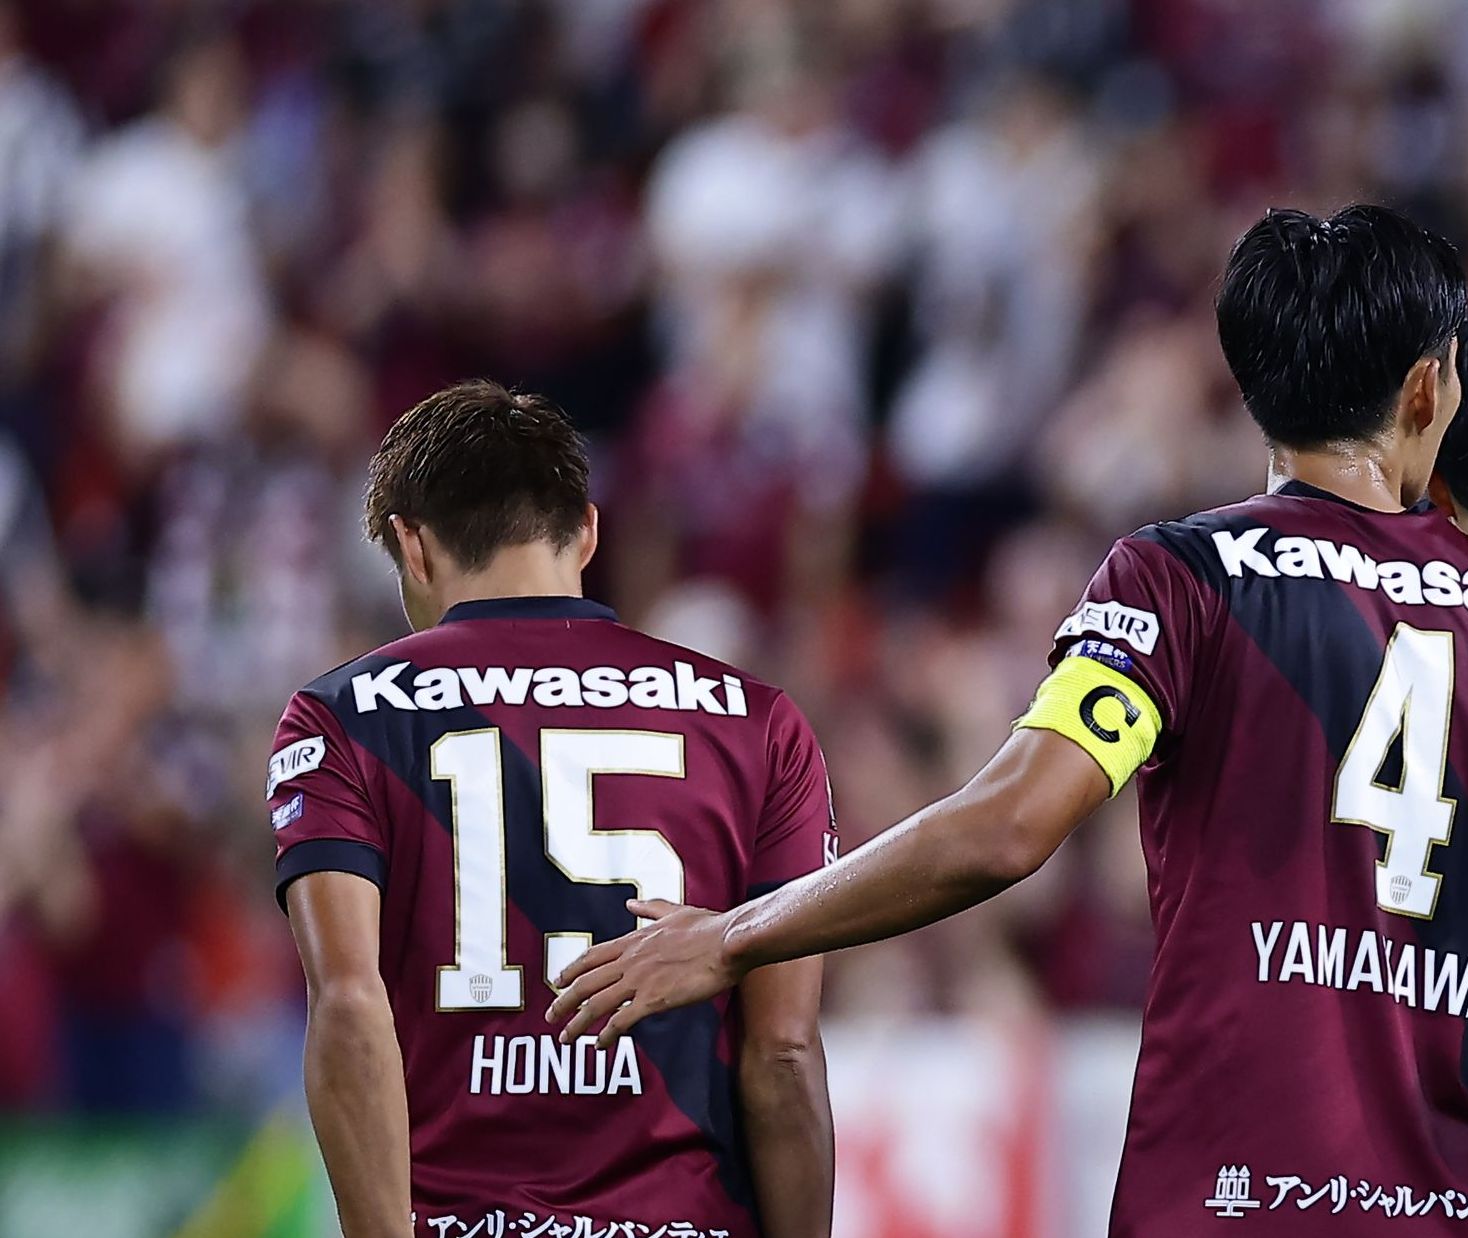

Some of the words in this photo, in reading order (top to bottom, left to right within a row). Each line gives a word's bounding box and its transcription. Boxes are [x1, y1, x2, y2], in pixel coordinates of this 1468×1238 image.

[351, 661, 748, 717] Kawasaki
[1079, 686, 1141, 743] C
[1331, 621, 1455, 920] 4
[430, 726, 687, 1013] 15
[470, 1035, 642, 1095] HONDA
